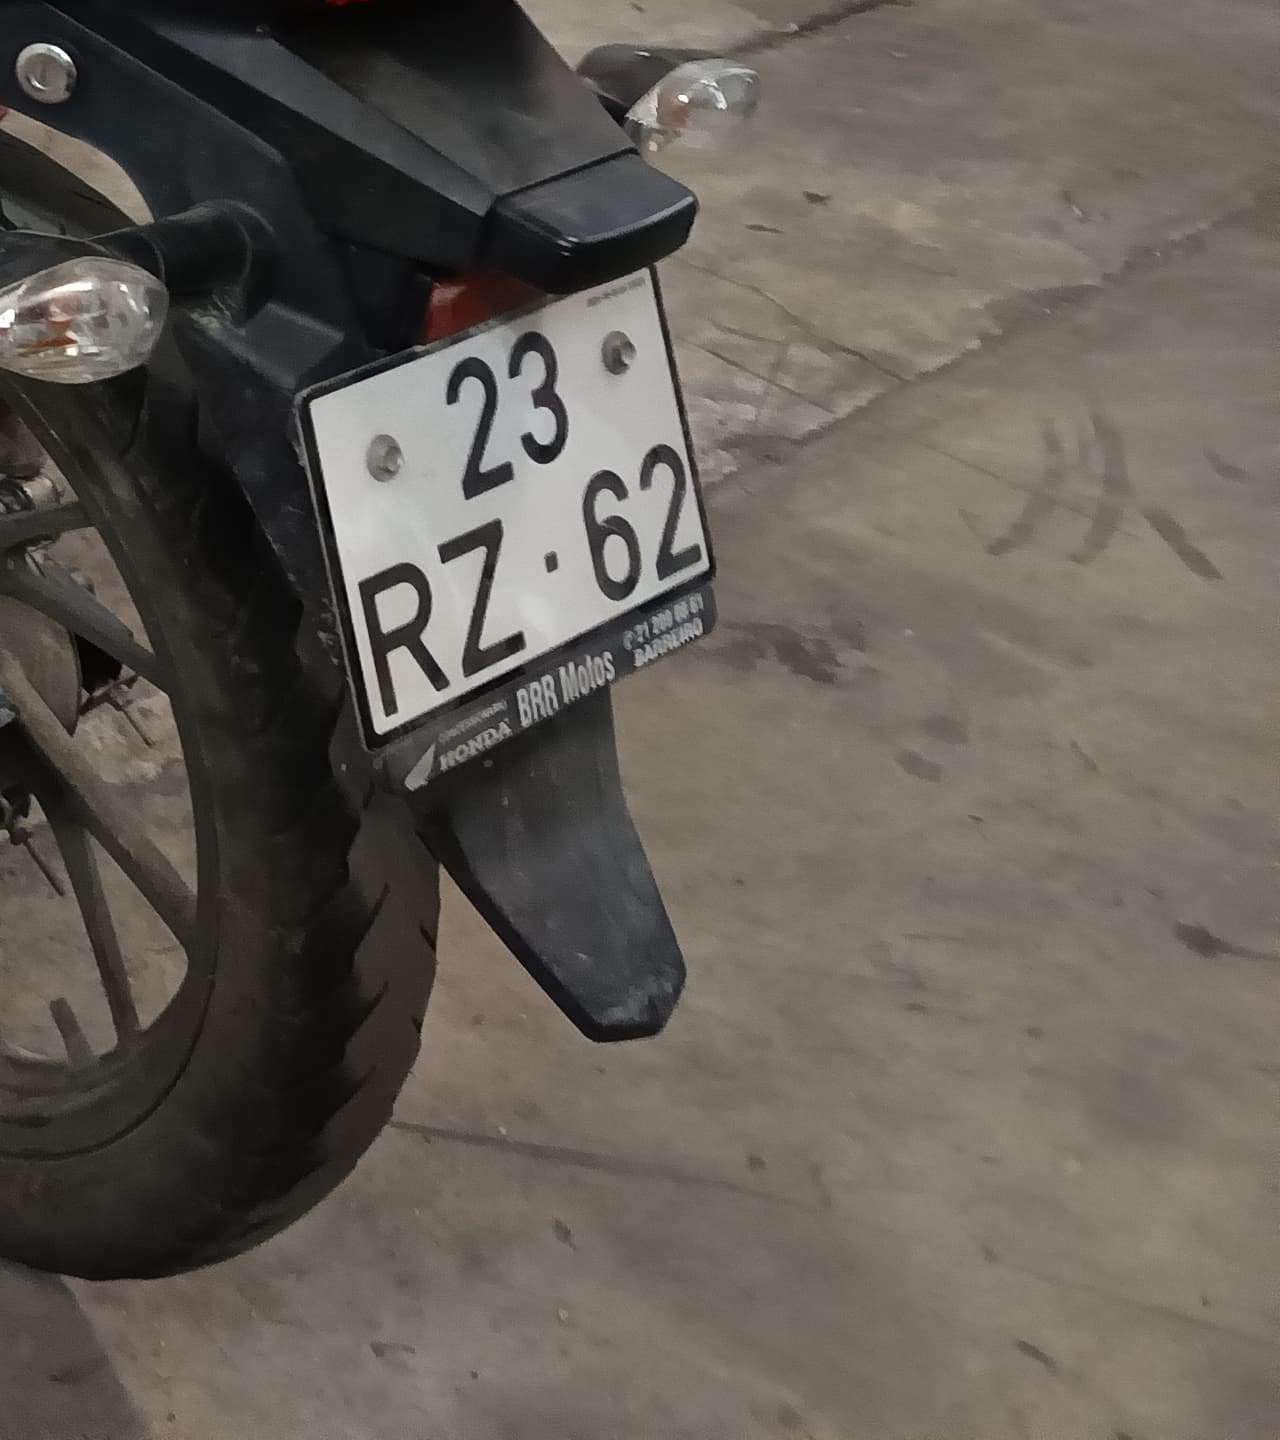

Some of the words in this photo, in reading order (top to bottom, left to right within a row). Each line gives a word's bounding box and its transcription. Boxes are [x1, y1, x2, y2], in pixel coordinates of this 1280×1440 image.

[445, 330, 569, 500] 23
[516, 674, 560, 728] BRR
[558, 650, 616, 704] Motos
[440, 721, 513, 772] HONDA
